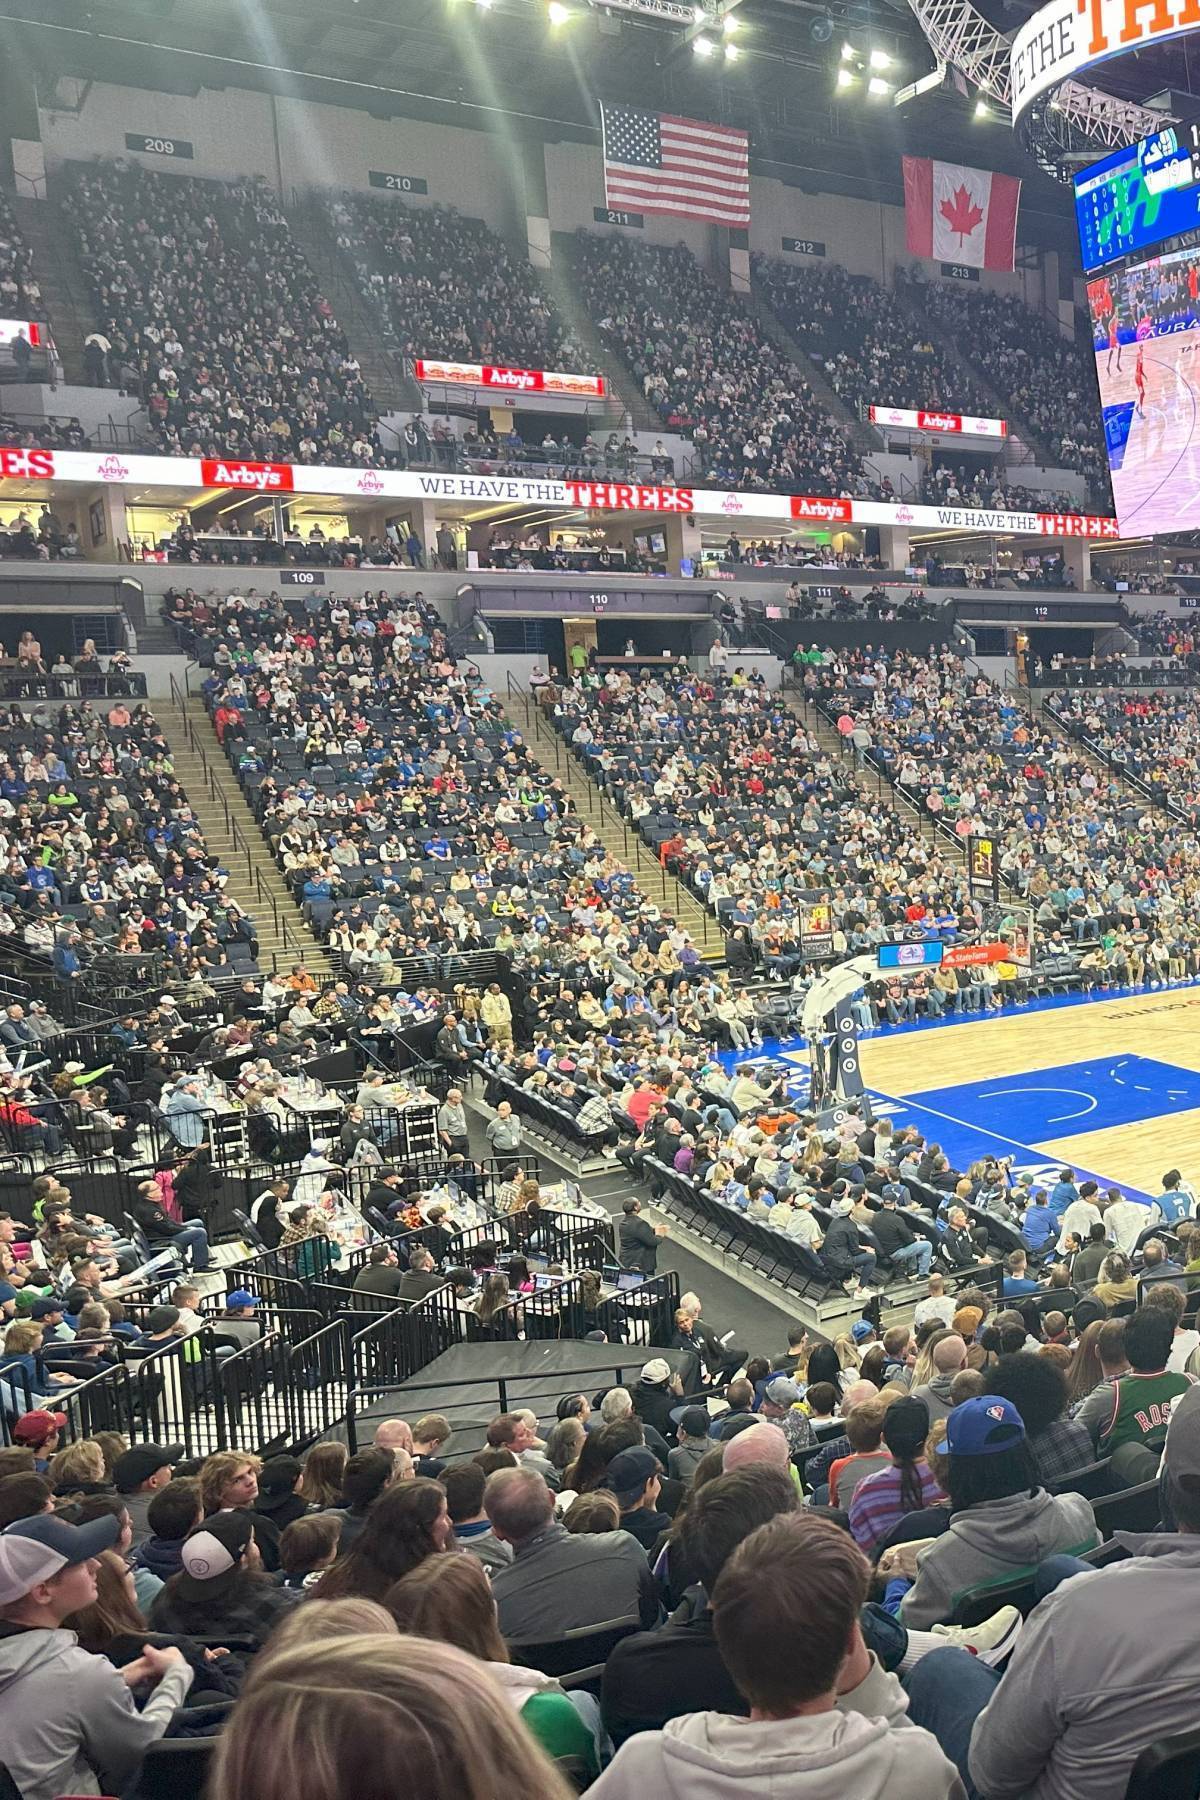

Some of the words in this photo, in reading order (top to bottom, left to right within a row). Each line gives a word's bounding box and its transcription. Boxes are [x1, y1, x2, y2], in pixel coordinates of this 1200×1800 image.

[1027, 13, 1074, 80] THE
[144, 138, 175, 154] 209
[1194, 167, 1200, 178] 6
[385, 176, 411, 191] 210
[607, 211, 629, 225] 211
[794, 241, 814, 254] 212
[951, 266, 969, 279] 213
[490, 365, 535, 388] Arby's
[922, 414, 956, 431] Arby's
[214, 463, 282, 489] Arby's
[420, 477, 455, 494] WE
[460, 480, 519, 499] HAVE
[522, 483, 565, 501] THE
[565, 480, 694, 513] THREES
[798, 499, 845, 521] Arby's
[937, 510, 963, 526] WE
[965, 512, 1006, 529] HAVE
[1009, 515, 1036, 530] THE
[1037, 513, 1119, 538] THREES
[292, 572, 313, 583] 109
[590, 594, 608, 604] 110
[817, 588, 832, 597] 111
[1185, 599, 1197, 607] 113
[1034, 606, 1047, 616] 112
[1134, 1402, 1171, 1433] ROS
